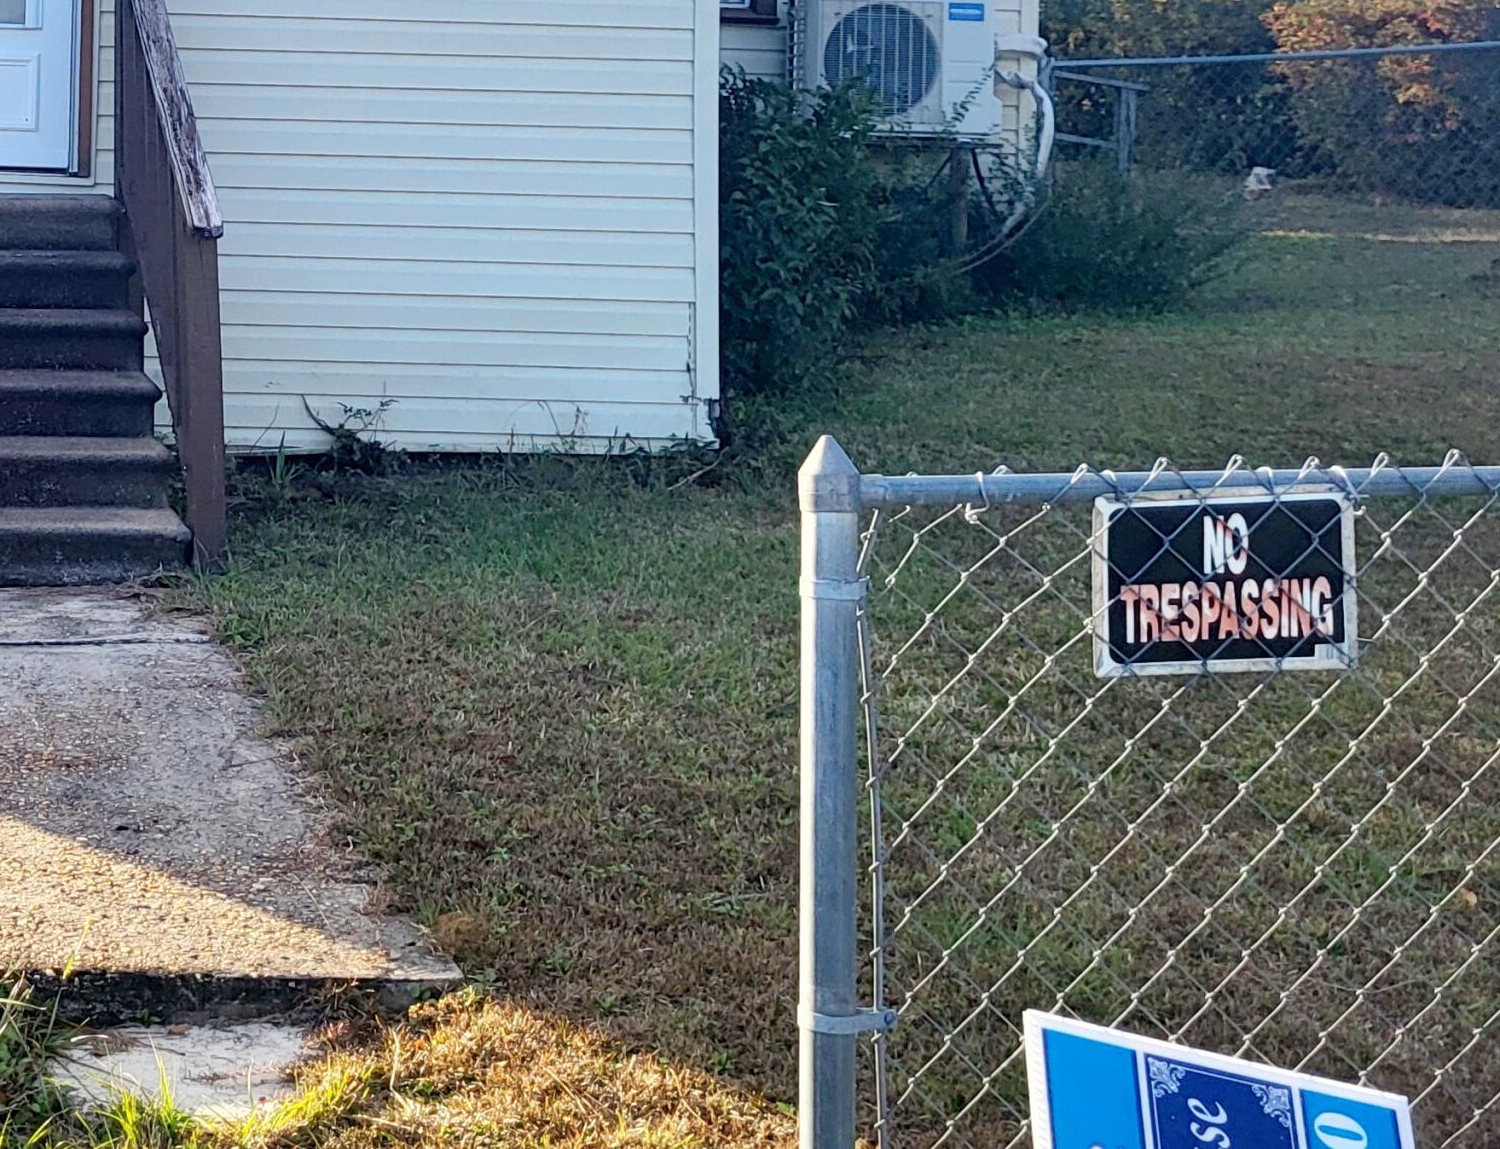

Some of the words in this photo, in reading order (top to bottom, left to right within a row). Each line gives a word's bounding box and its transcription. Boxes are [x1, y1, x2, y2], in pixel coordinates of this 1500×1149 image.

[1203, 512, 1249, 575] NO
[1120, 576, 1334, 644] TRESPASSING
[1187, 1097, 1232, 1149] se
